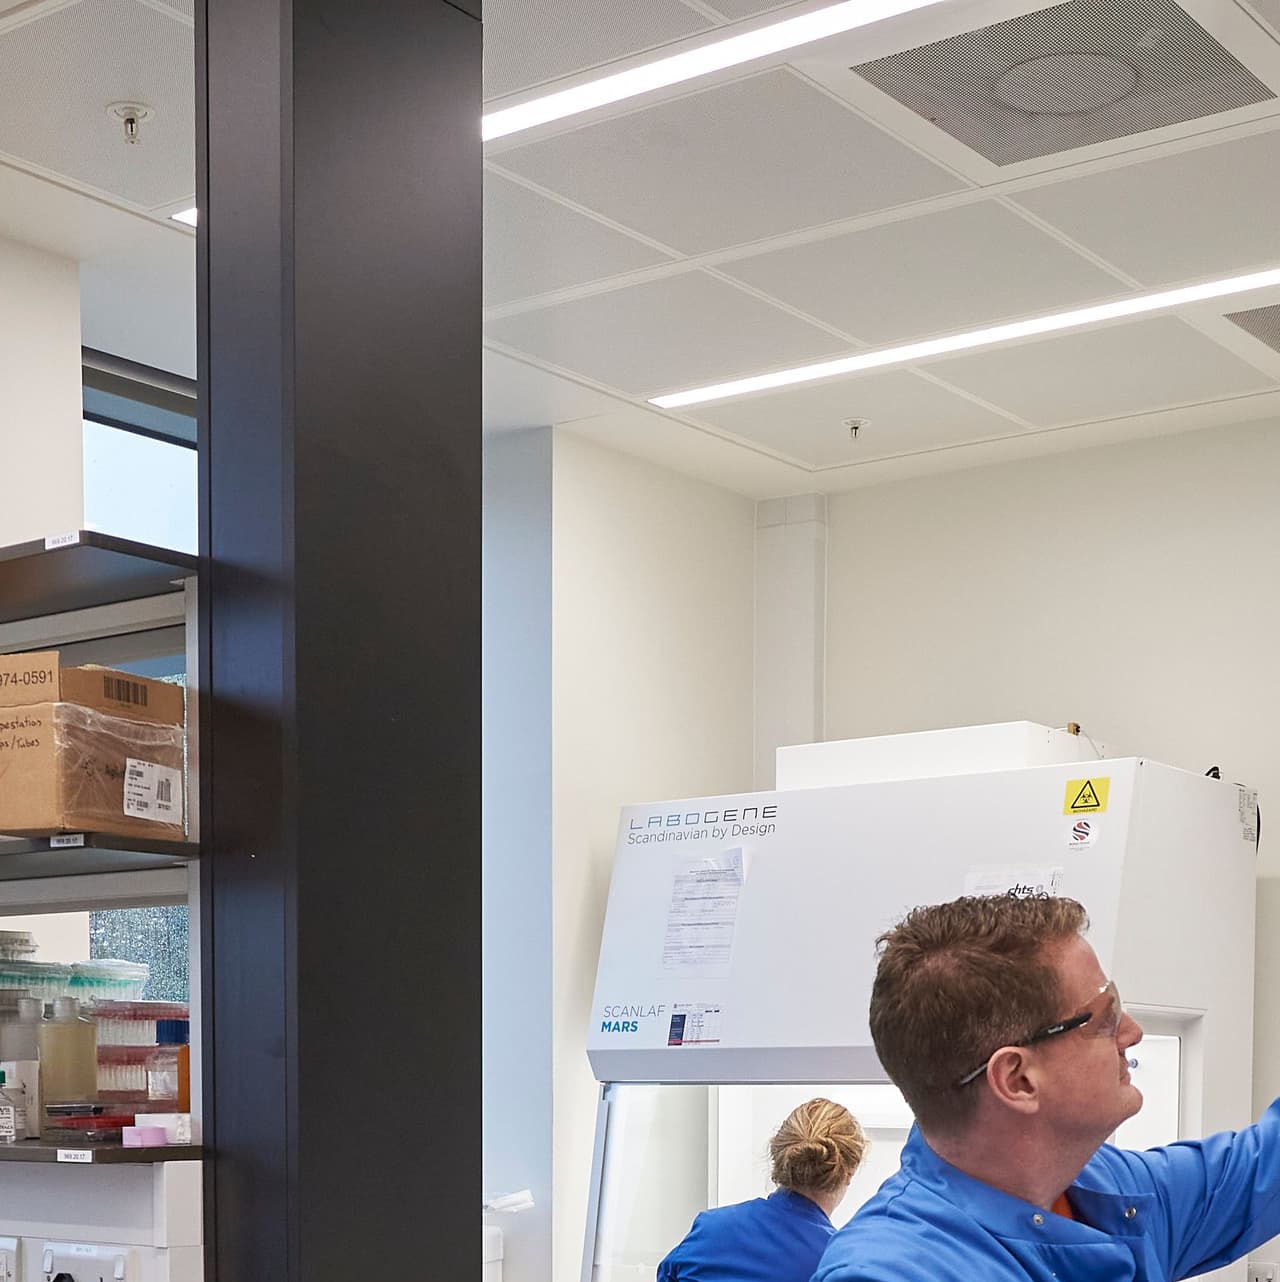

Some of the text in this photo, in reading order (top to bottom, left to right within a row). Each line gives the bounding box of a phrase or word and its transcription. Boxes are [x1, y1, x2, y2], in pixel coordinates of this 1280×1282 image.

[630, 806, 778, 830] LABOGENE
[628, 822, 776, 845] Scandinavian by Design
[604, 1004, 666, 1018] SCANLAF
[601, 1021, 638, 1033] MARS
